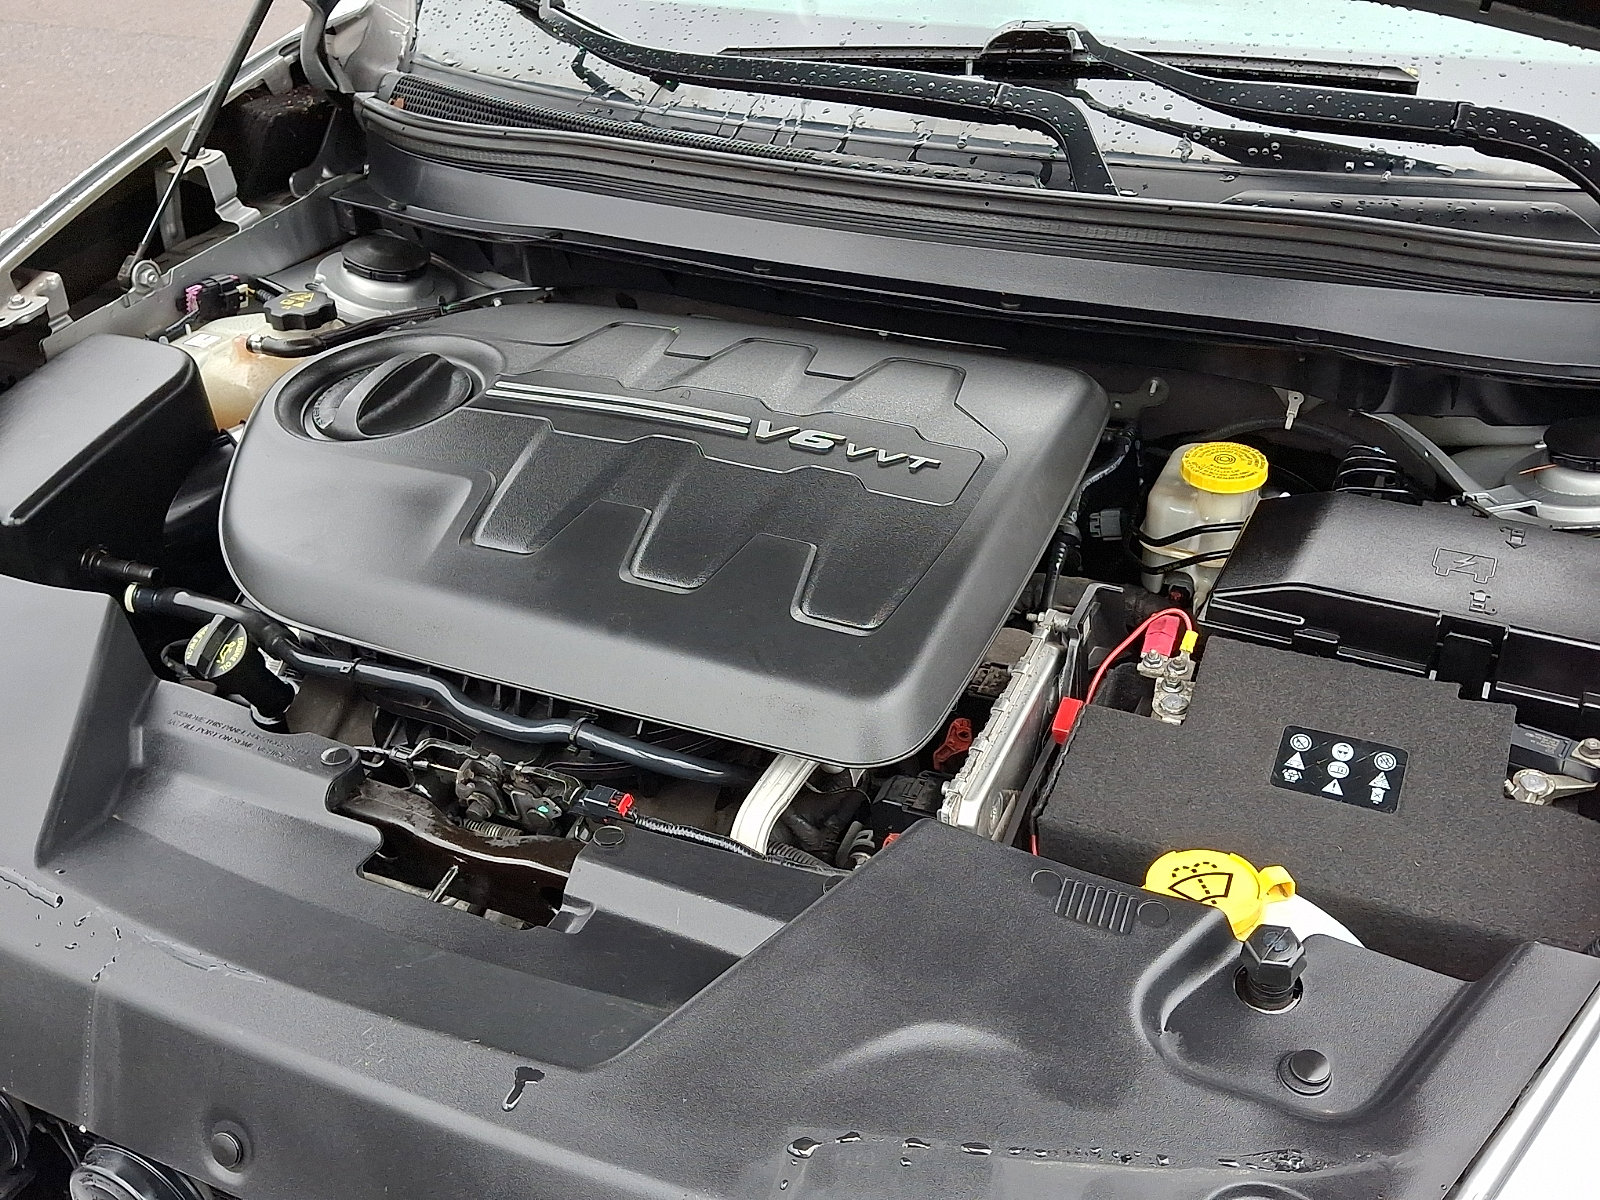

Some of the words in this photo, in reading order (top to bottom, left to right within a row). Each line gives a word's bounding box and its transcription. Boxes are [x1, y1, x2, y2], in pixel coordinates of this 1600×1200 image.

[755, 419, 847, 455] V6
[846, 443, 942, 474] VVT
[230, 636, 244, 661] ENGINE
[219, 661, 232, 671] OIL
[179, 722, 196, 731] FILL
[195, 726, 219, 738] PORT
[218, 733, 233, 742] ON
[231, 737, 254, 749] SOME
[205, 719, 223, 728] THIS
[221, 724, 247, 736] PANEL
